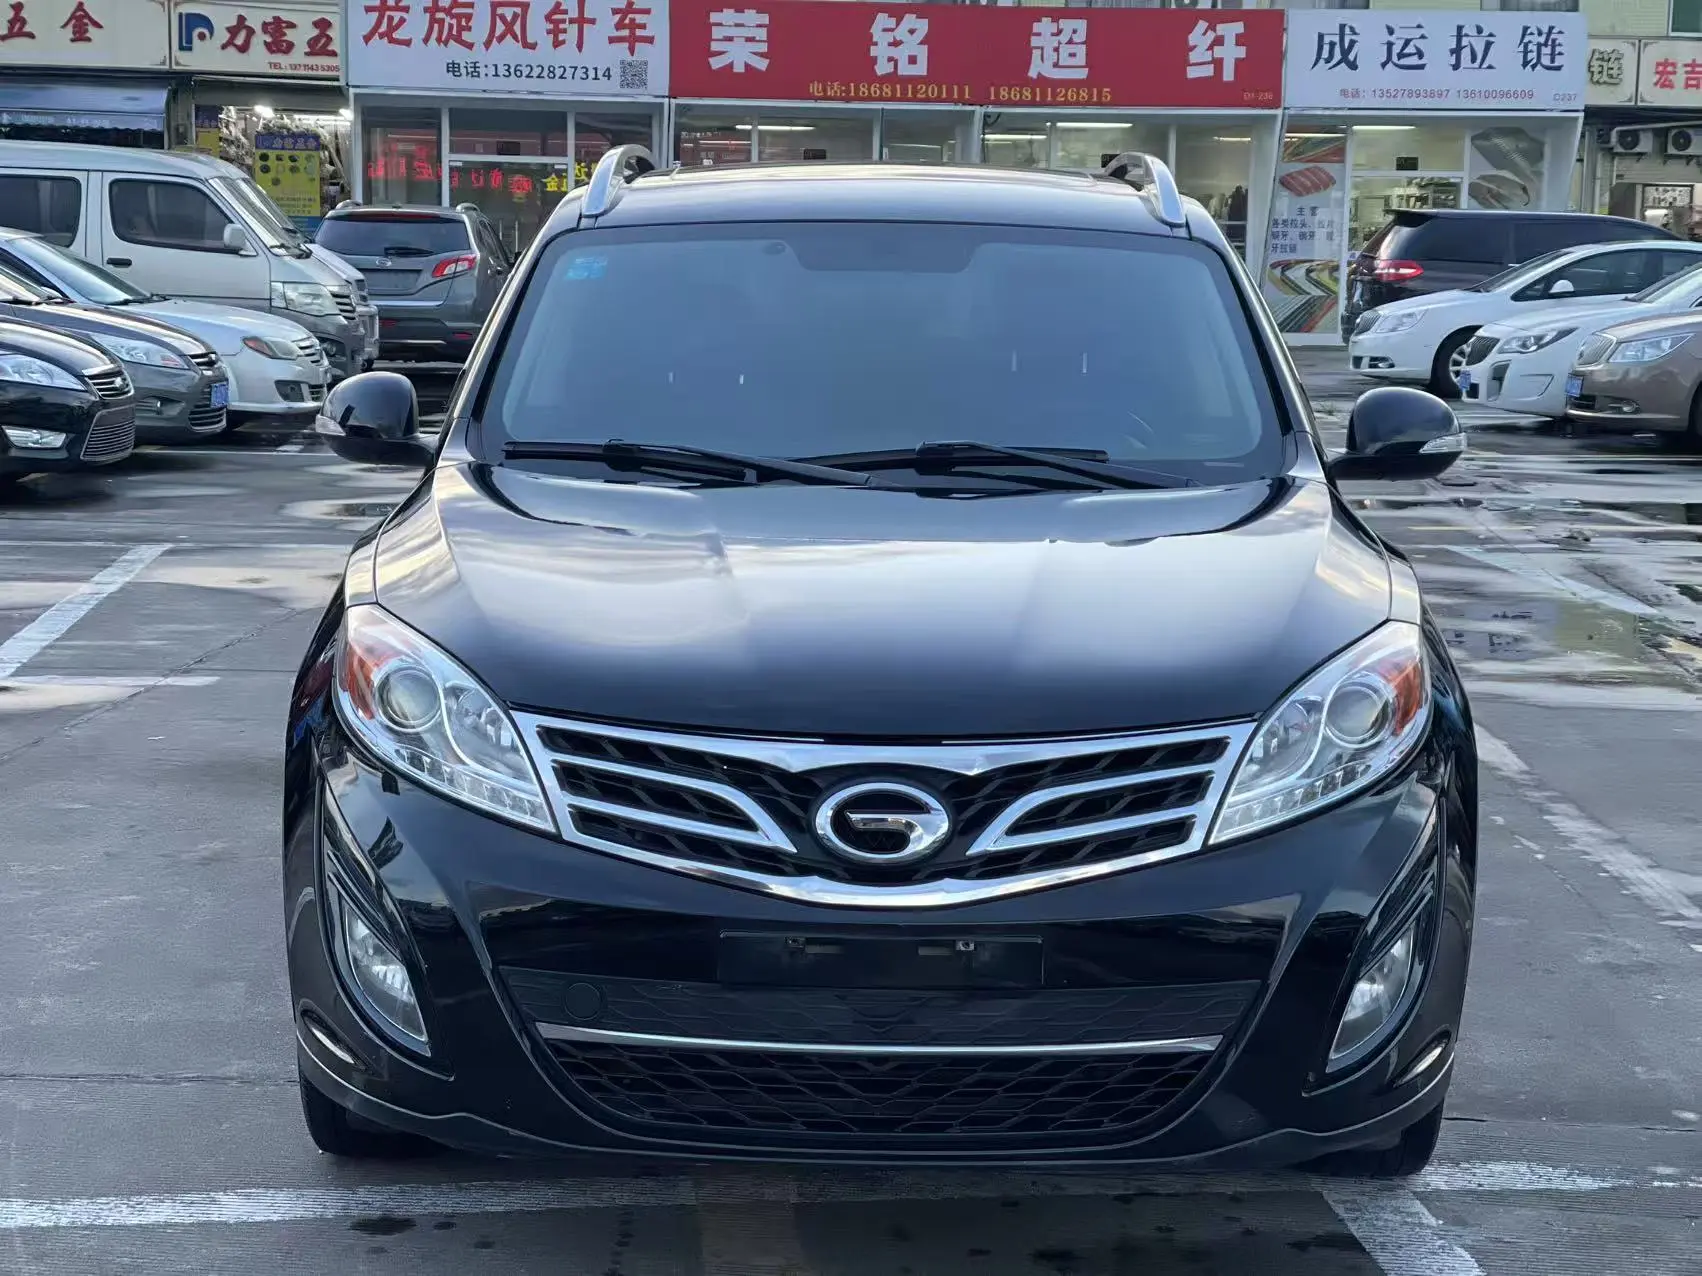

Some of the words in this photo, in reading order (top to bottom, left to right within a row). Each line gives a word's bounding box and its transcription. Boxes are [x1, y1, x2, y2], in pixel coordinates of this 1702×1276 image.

[0, 1, 104, 43] 五金
[221, 14, 338, 57] 力富五
[362, 0, 656, 57] 龙旋风针车
[1310, 23, 1566, 73] 成运拉链
[1588, 48, 1625, 86] 链
[989, 86, 1112, 103] 18681126815
[1653, 57, 1702, 90] 宏吉
